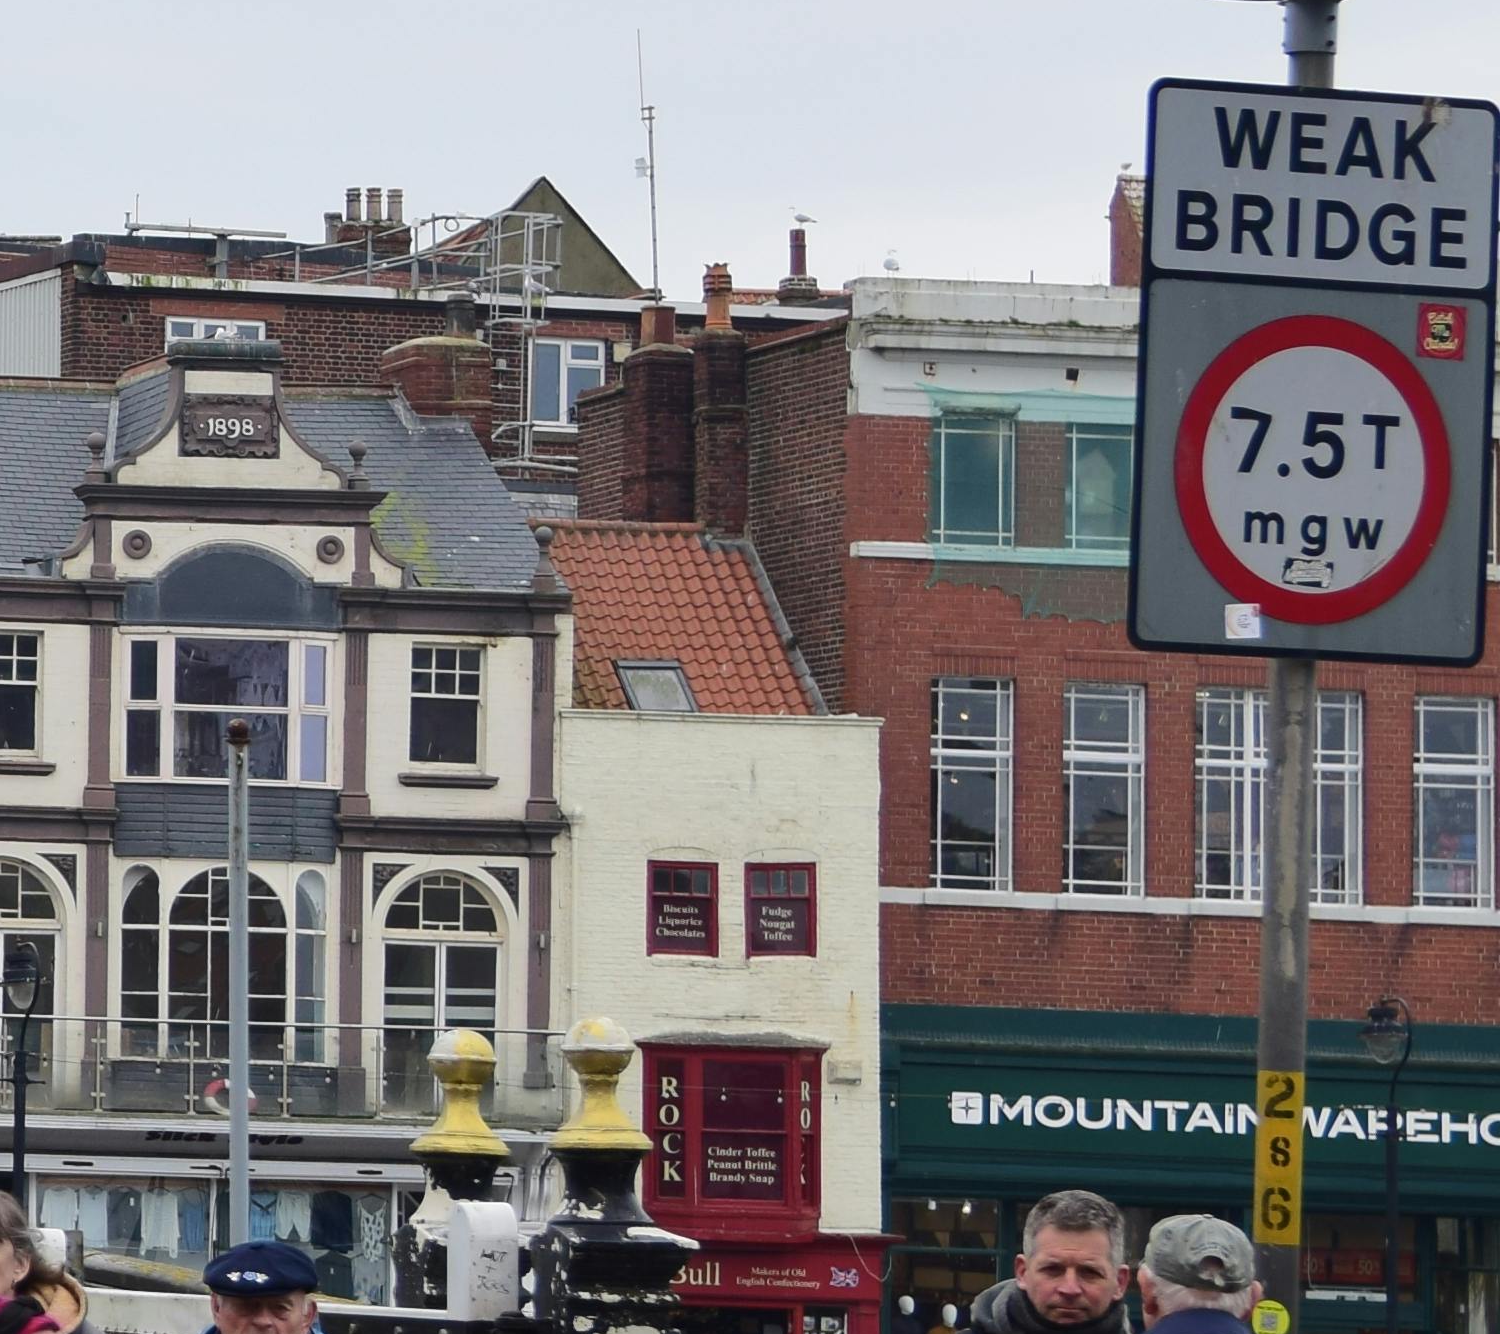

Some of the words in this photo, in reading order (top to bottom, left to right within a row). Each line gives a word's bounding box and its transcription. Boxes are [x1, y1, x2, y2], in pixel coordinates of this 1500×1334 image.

[1214, 106, 1437, 183] WEAK
[1175, 189, 1468, 270] BRIDGE
[207, 417, 254, 438] 1898
[663, 904, 699, 914] Biscuits
[762, 906, 793, 918] Fudge
[659, 916, 703, 927] Liquorice
[759, 918, 795, 930] Nougat
[656, 927, 706, 939] Chocolates
[763, 930, 794, 942] Toffee
[659, 1076, 683, 1182] ROCK
[707, 1146, 743, 1157] Cinder
[746, 1147, 776, 1158] Toffee
[707, 1159, 742, 1169] Peanut
[744, 1160, 777, 1171] Brittle
[709, 1172, 746, 1184] Brandy
[749, 1173, 775, 1186] Snap
[751, 1267, 780, 1276] Makers
[781, 1268, 790, 1276] of
[790, 1268, 806, 1278] Old
[736, 1276, 765, 1287] English
[766, 1277, 821, 1290] Confectionery
